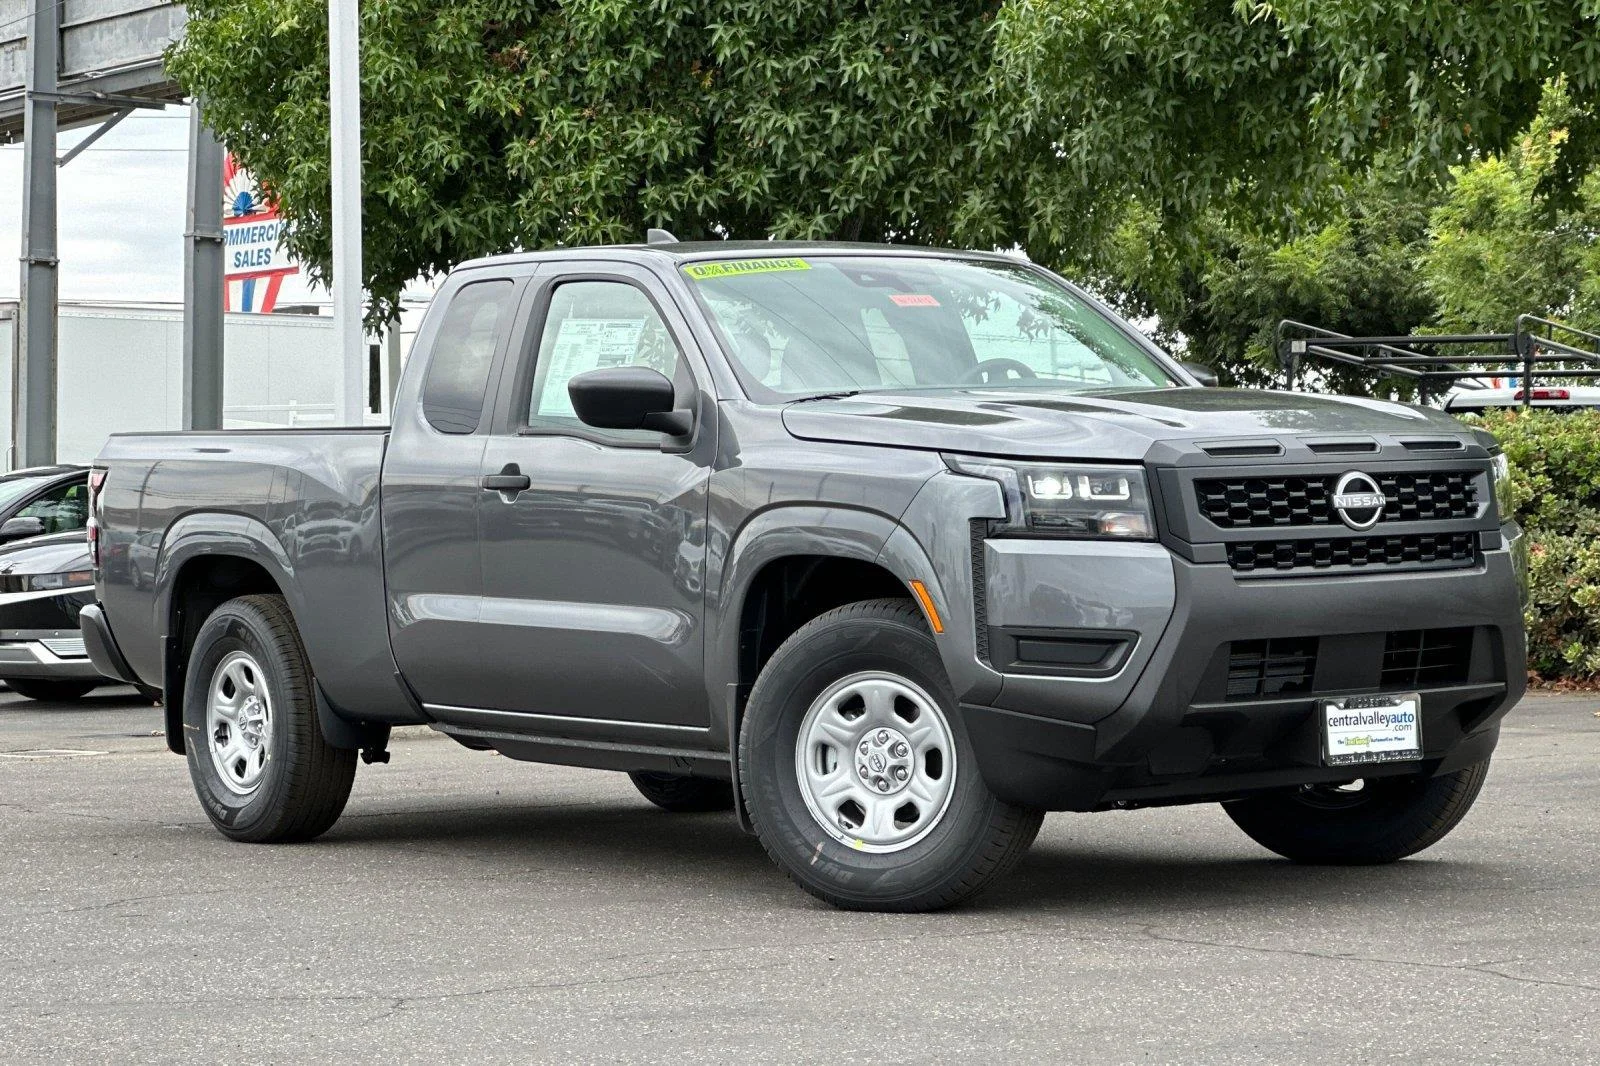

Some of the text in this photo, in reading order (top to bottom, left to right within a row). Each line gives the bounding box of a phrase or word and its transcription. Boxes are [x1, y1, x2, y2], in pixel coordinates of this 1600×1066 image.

[223, 222, 286, 246] OMMERCI
[234, 247, 272, 268] SALES
[1335, 496, 1386, 507] NISSAN
[1328, 710, 1415, 728] centralvalleyauto
[1392, 723, 1412, 733] .com
